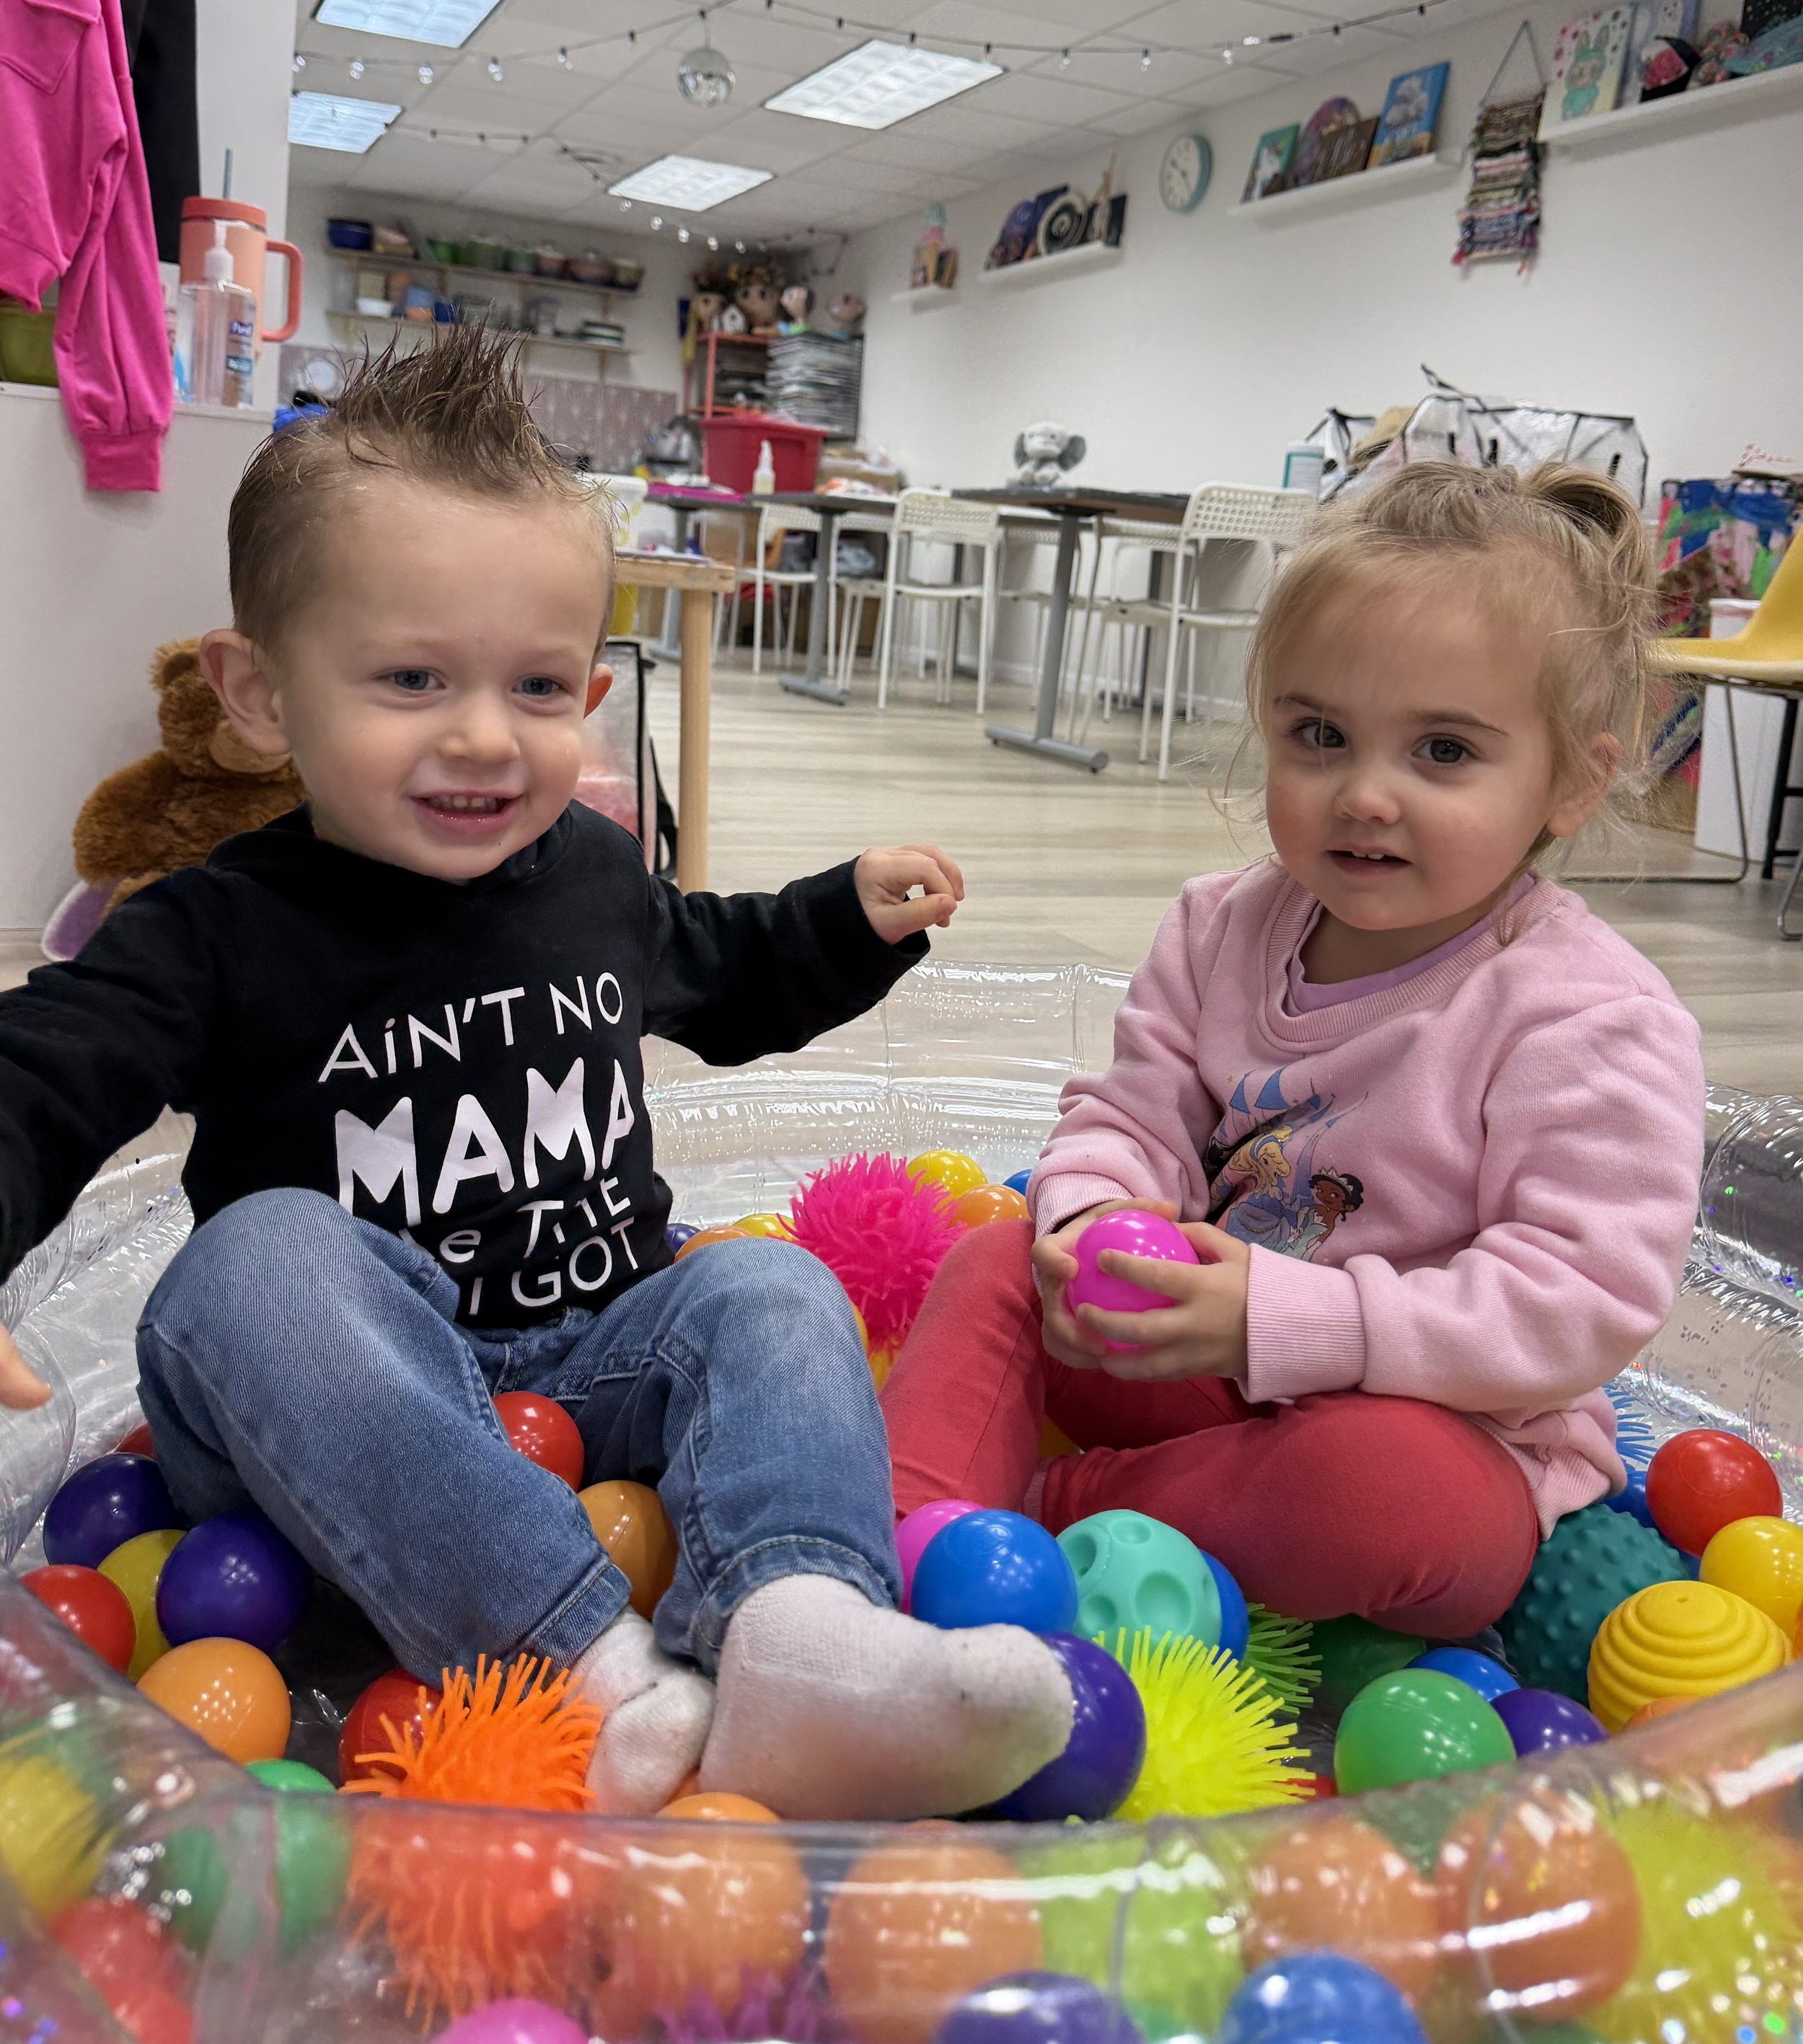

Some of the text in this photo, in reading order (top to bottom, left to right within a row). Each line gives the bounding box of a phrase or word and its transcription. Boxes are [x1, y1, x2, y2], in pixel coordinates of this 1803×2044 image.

[549, 972, 623, 1035] NO
[335, 1057, 635, 1226] MAMA
[511, 1216, 639, 1308] GOT
